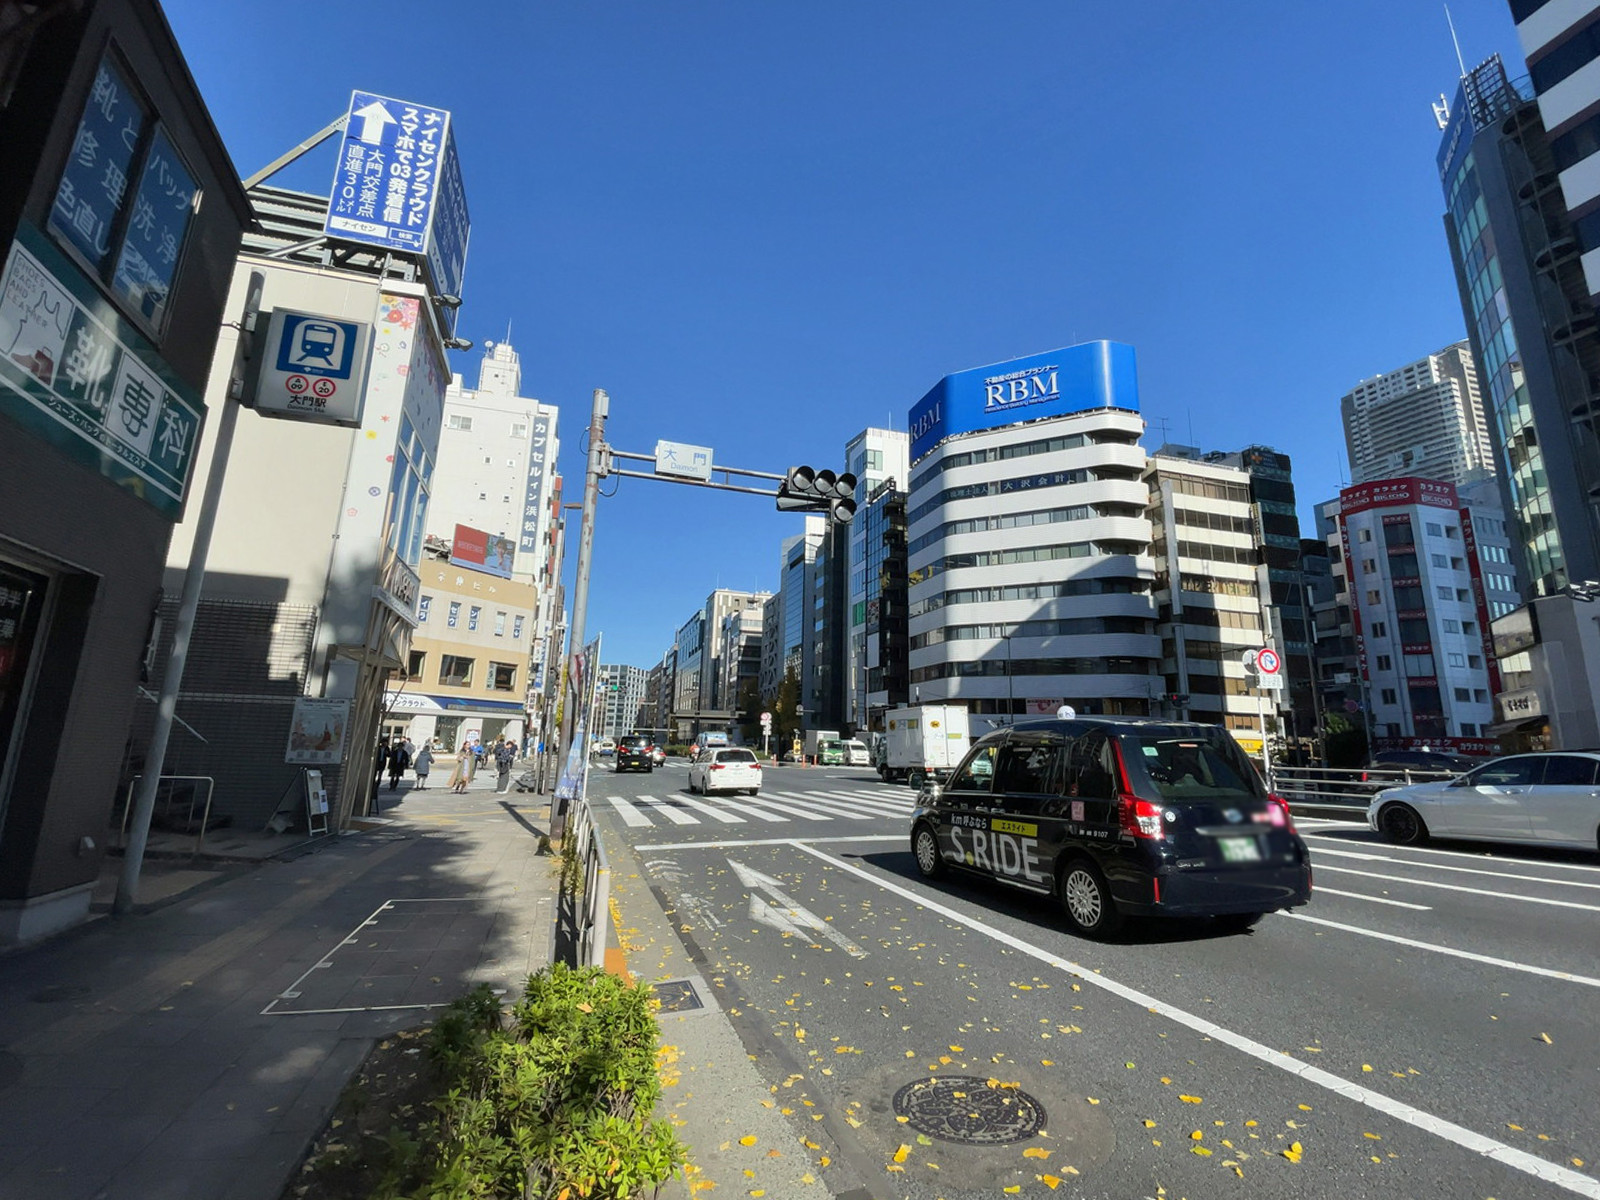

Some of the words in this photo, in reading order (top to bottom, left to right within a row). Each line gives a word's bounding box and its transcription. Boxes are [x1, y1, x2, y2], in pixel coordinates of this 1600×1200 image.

[76, 120, 128, 210] 修理
[383, 107, 420, 224] スマホで03発着信
[407, 113, 442, 226] ナイセンクラウド
[356, 149, 385, 219] 大門交差点
[54, 177, 111, 256] 色直し
[341, 220, 377, 232] ナイセン
[13, 267, 36, 293] BAGS
[17, 257, 45, 288] SHOES
[9, 280, 29, 299] AND
[289, 395, 327, 407] 大門駅
[985, 372, 1060, 407] RBM
[911, 400, 942, 444] RBM
[664, 448, 707, 466] 大門
[670, 462, 698, 473] Daimon
[521, 422, 547, 548] カプセルイン浜松町
[1004, 474, 1065, 490] 大沢会計
[1373, 484, 1408, 493] カラオケ
[1420, 482, 1449, 495] カラオケ
[951, 826, 1043, 883] S.RIDE
